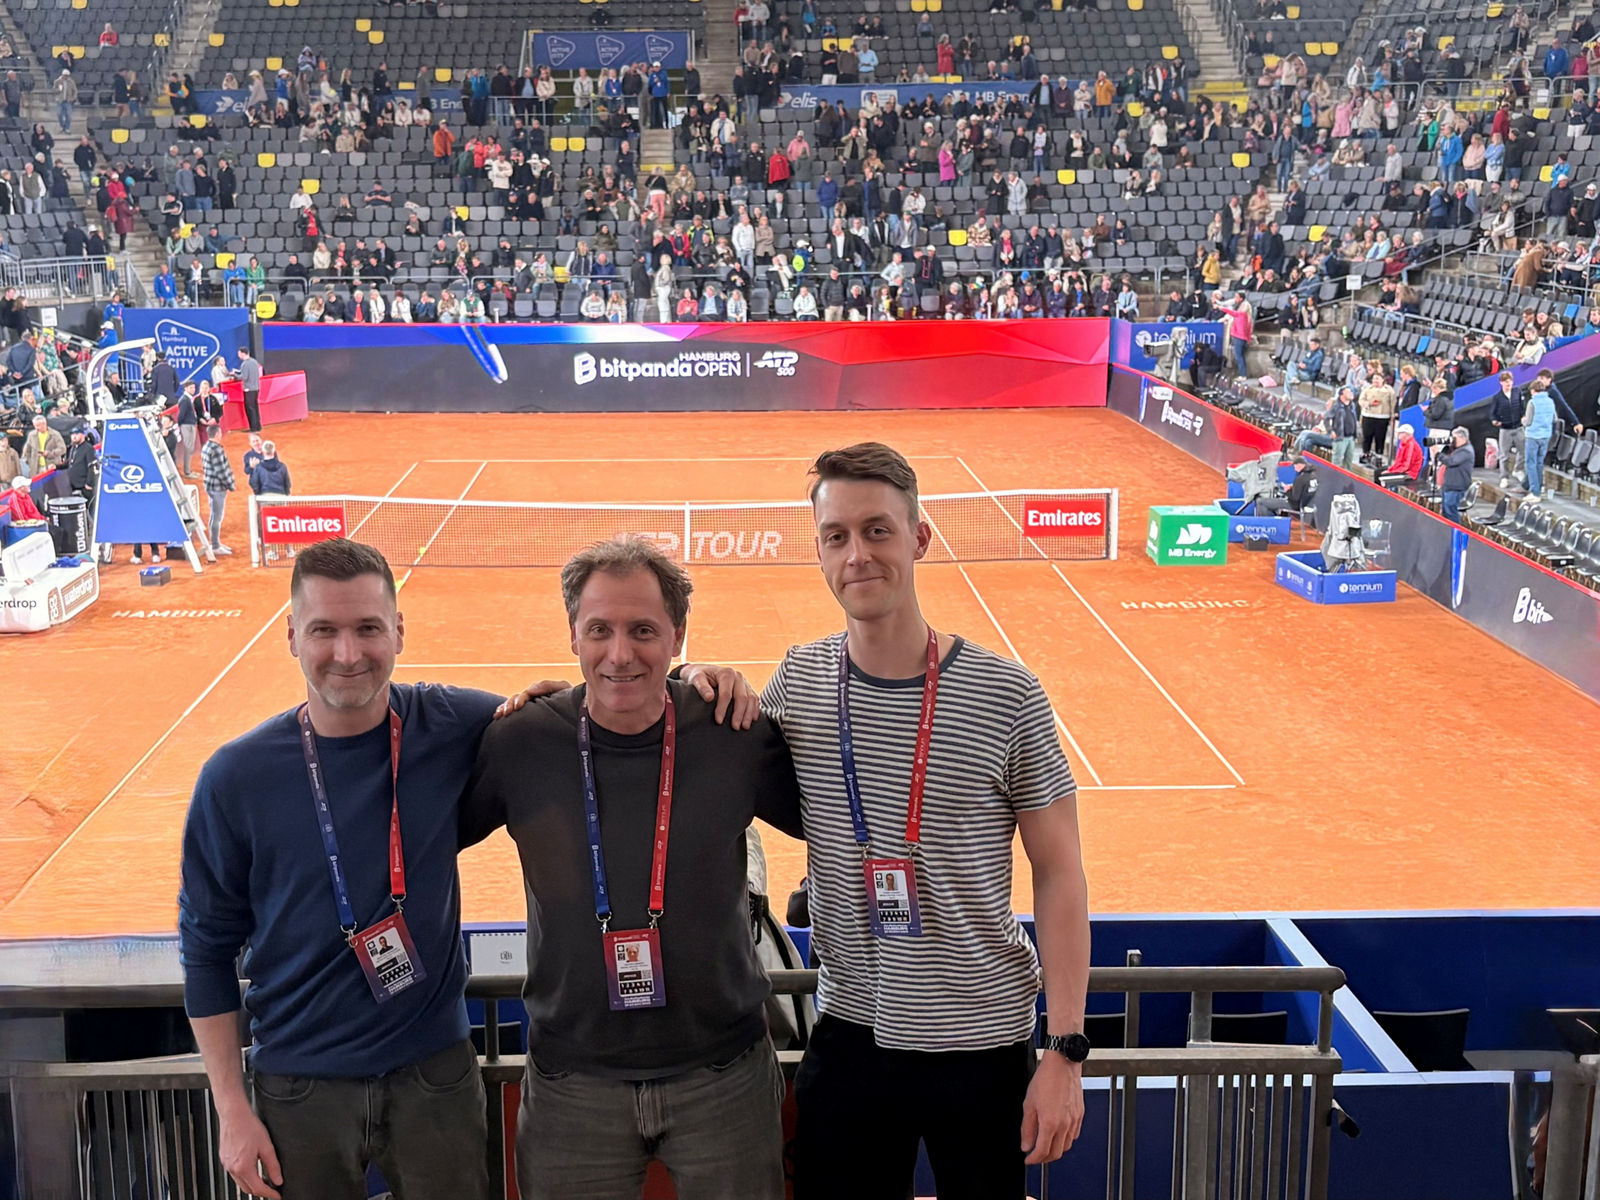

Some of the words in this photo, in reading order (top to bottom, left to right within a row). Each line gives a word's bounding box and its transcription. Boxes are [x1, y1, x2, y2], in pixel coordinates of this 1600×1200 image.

[791, 92, 818, 108] elis
[166, 346, 208, 356] ACTIVE
[680, 352, 741, 361] HAMBURG
[168, 358, 194, 369] CITY
[754, 351, 799, 368] ATP
[600, 358, 692, 381] bitpanda
[694, 362, 741, 376] OPEN
[777, 366, 796, 376] 500
[104, 482, 163, 494] LEXUS
[1028, 508, 1102, 526] Emirates
[266, 516, 342, 532] Emirates
[692, 530, 782, 558] TOUR
[1168, 548, 1184, 557] MB
[1184, 548, 1216, 558] Energy
[1348, 583, 1382, 592] tennium
[112, 610, 243, 618] HAMBURG
